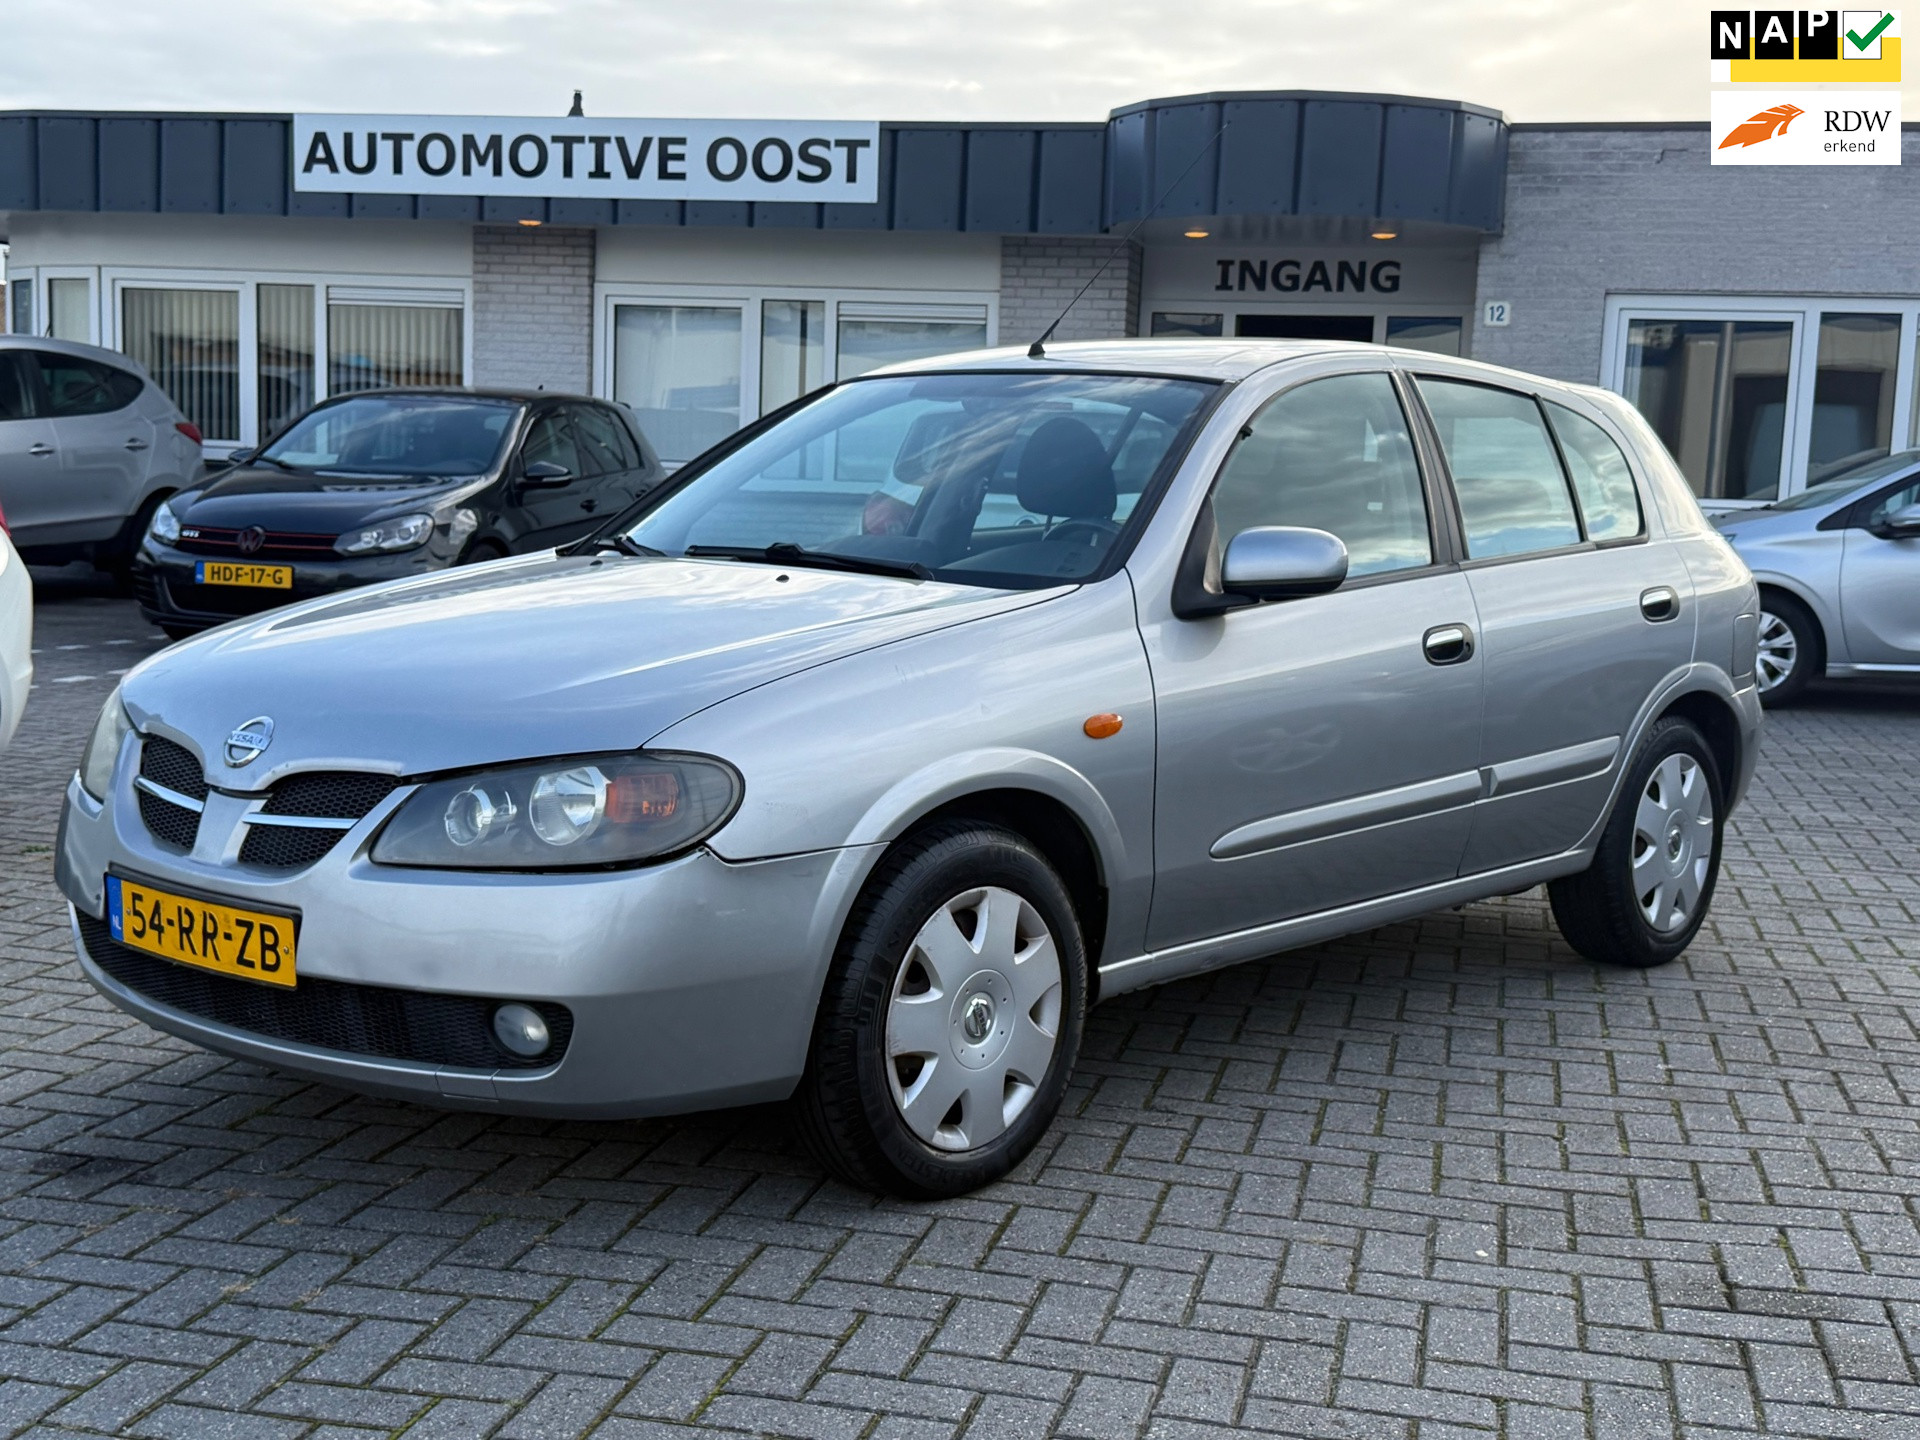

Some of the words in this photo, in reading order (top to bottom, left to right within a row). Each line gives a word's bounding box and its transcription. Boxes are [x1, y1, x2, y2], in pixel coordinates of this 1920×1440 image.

[302, 131, 688, 181] AUTOMOTIVE
[706, 136, 870, 184] OOST
[1214, 259, 1402, 293] INGANG
[1488, 305, 1505, 322] 12
[210, 565, 284, 585] HDF-17-G
[131, 891, 281, 973] 54-RR-ZB
